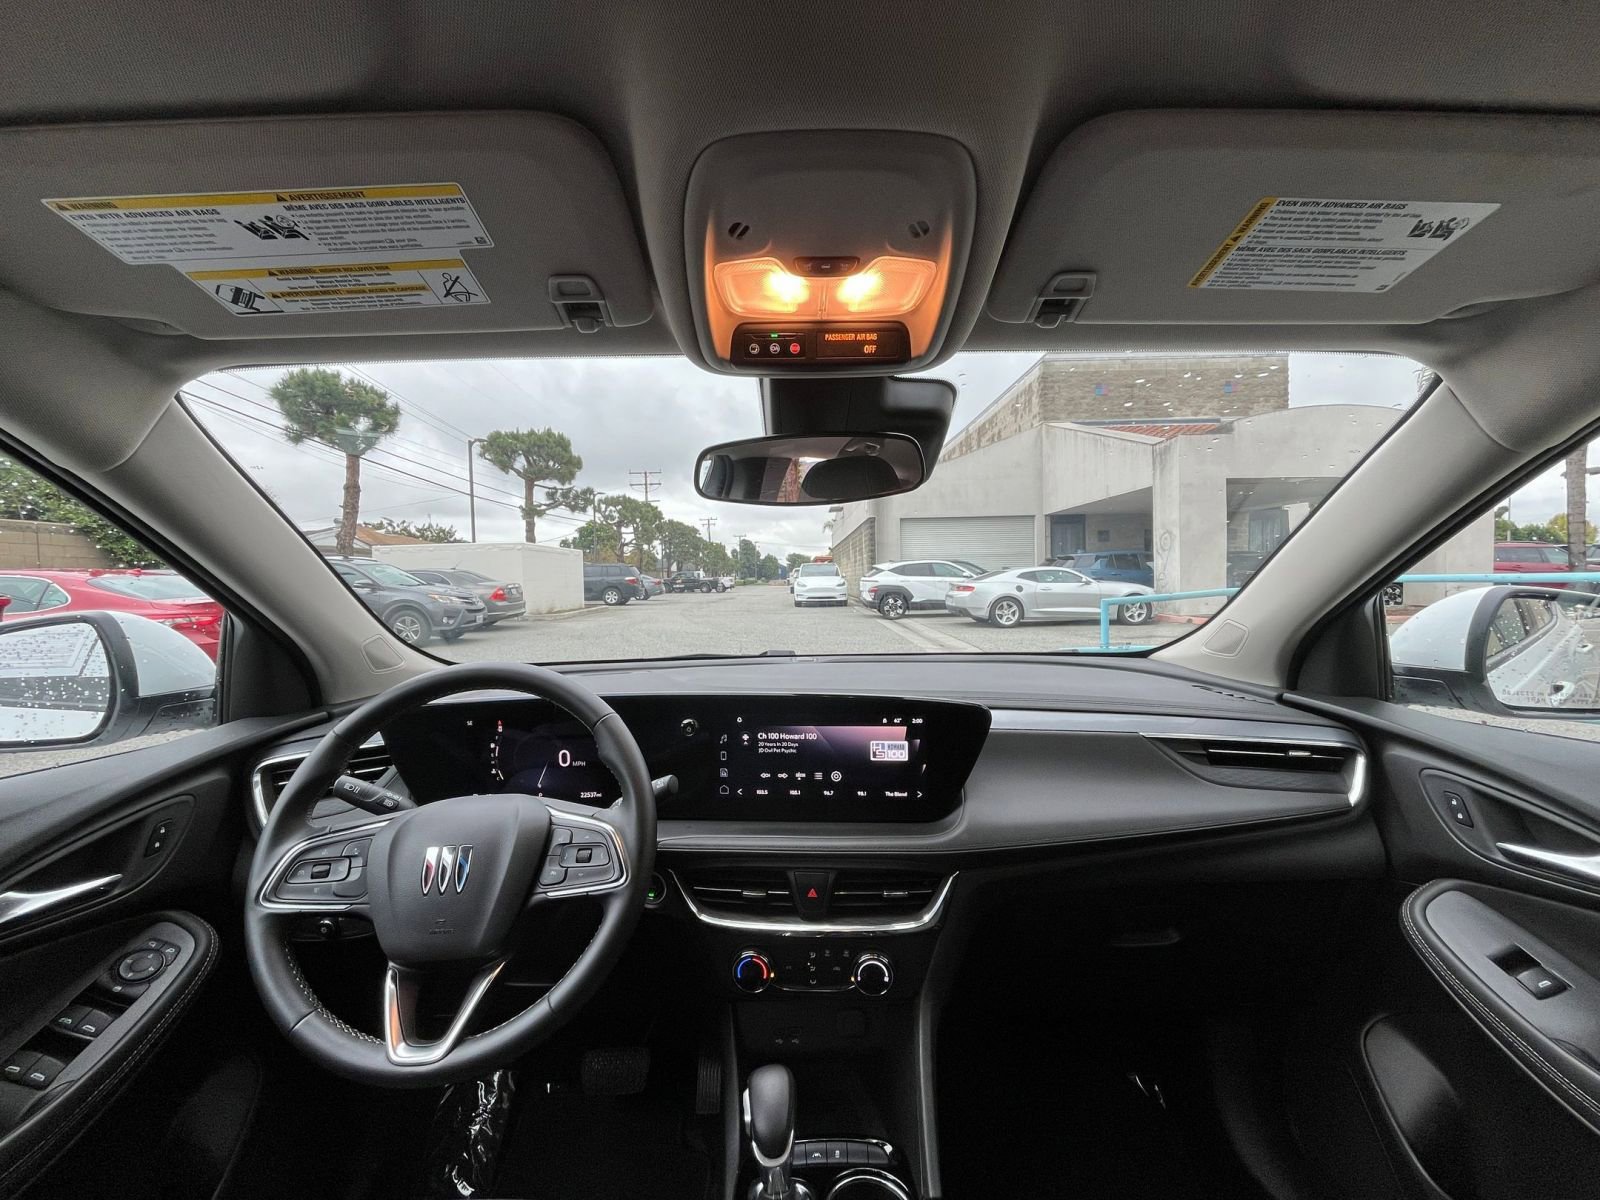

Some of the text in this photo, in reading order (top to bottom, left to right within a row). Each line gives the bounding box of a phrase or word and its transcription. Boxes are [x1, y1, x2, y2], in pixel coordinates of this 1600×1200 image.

[288, 191, 365, 201] AVERTISSEMENT
[69, 202, 118, 210] WARNING
[415, 197, 465, 206] INTELLIGENTS
[123, 210, 174, 218] ADVANCED
[192, 208, 221, 216] BAGS
[824, 333, 877, 341] PASSENGER AIR BAG
[863, 344, 877, 354] OFF
[757, 732, 817, 740] Ch 100 Howard 100
[558, 749, 571, 767] 0
[887, 750, 905, 759] 100
